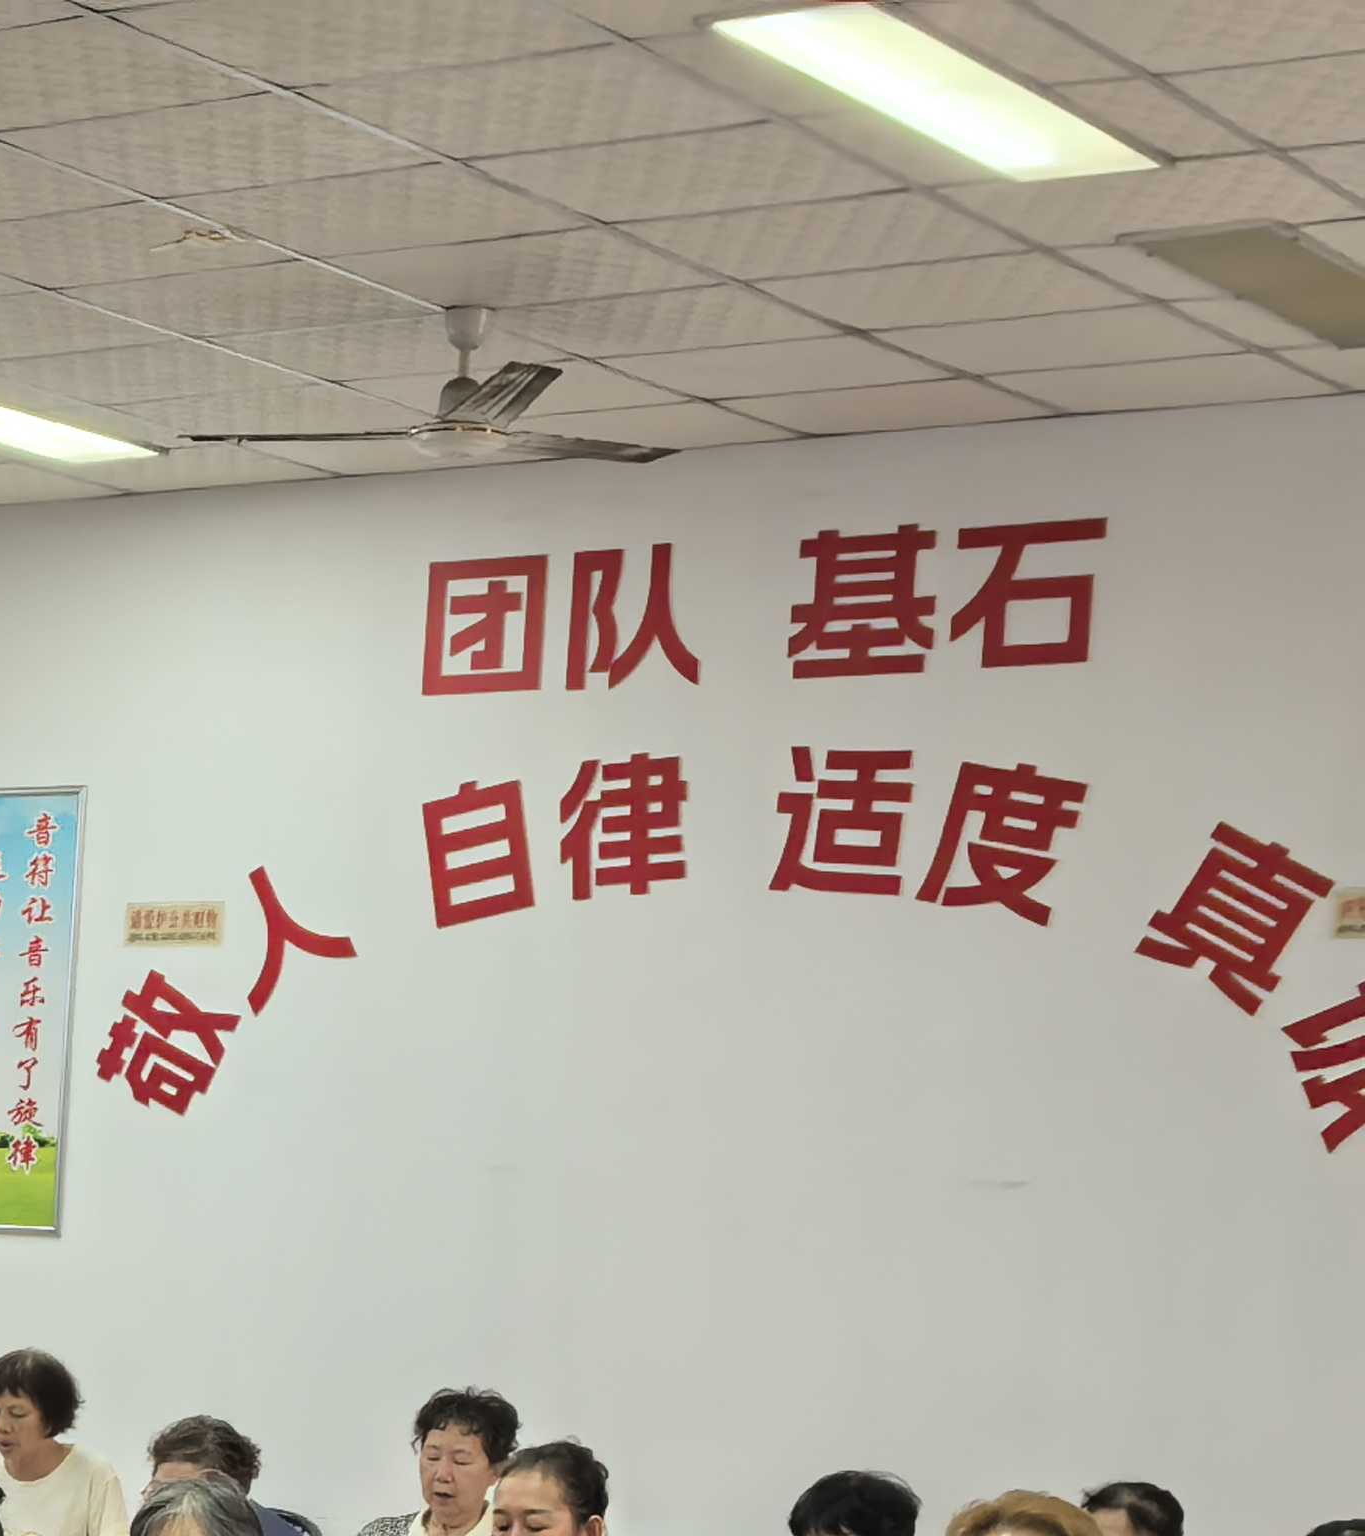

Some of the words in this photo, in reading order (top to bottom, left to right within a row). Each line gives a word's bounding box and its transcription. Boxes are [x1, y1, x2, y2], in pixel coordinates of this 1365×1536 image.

[422, 543, 701, 698] 团队
[786, 518, 1107, 681] 基石
[7, 812, 60, 1170] 音符让音乐有了旋律
[96, 866, 357, 1116] 敬人
[422, 753, 689, 928] 自律
[769, 745, 1088, 926] 适度
